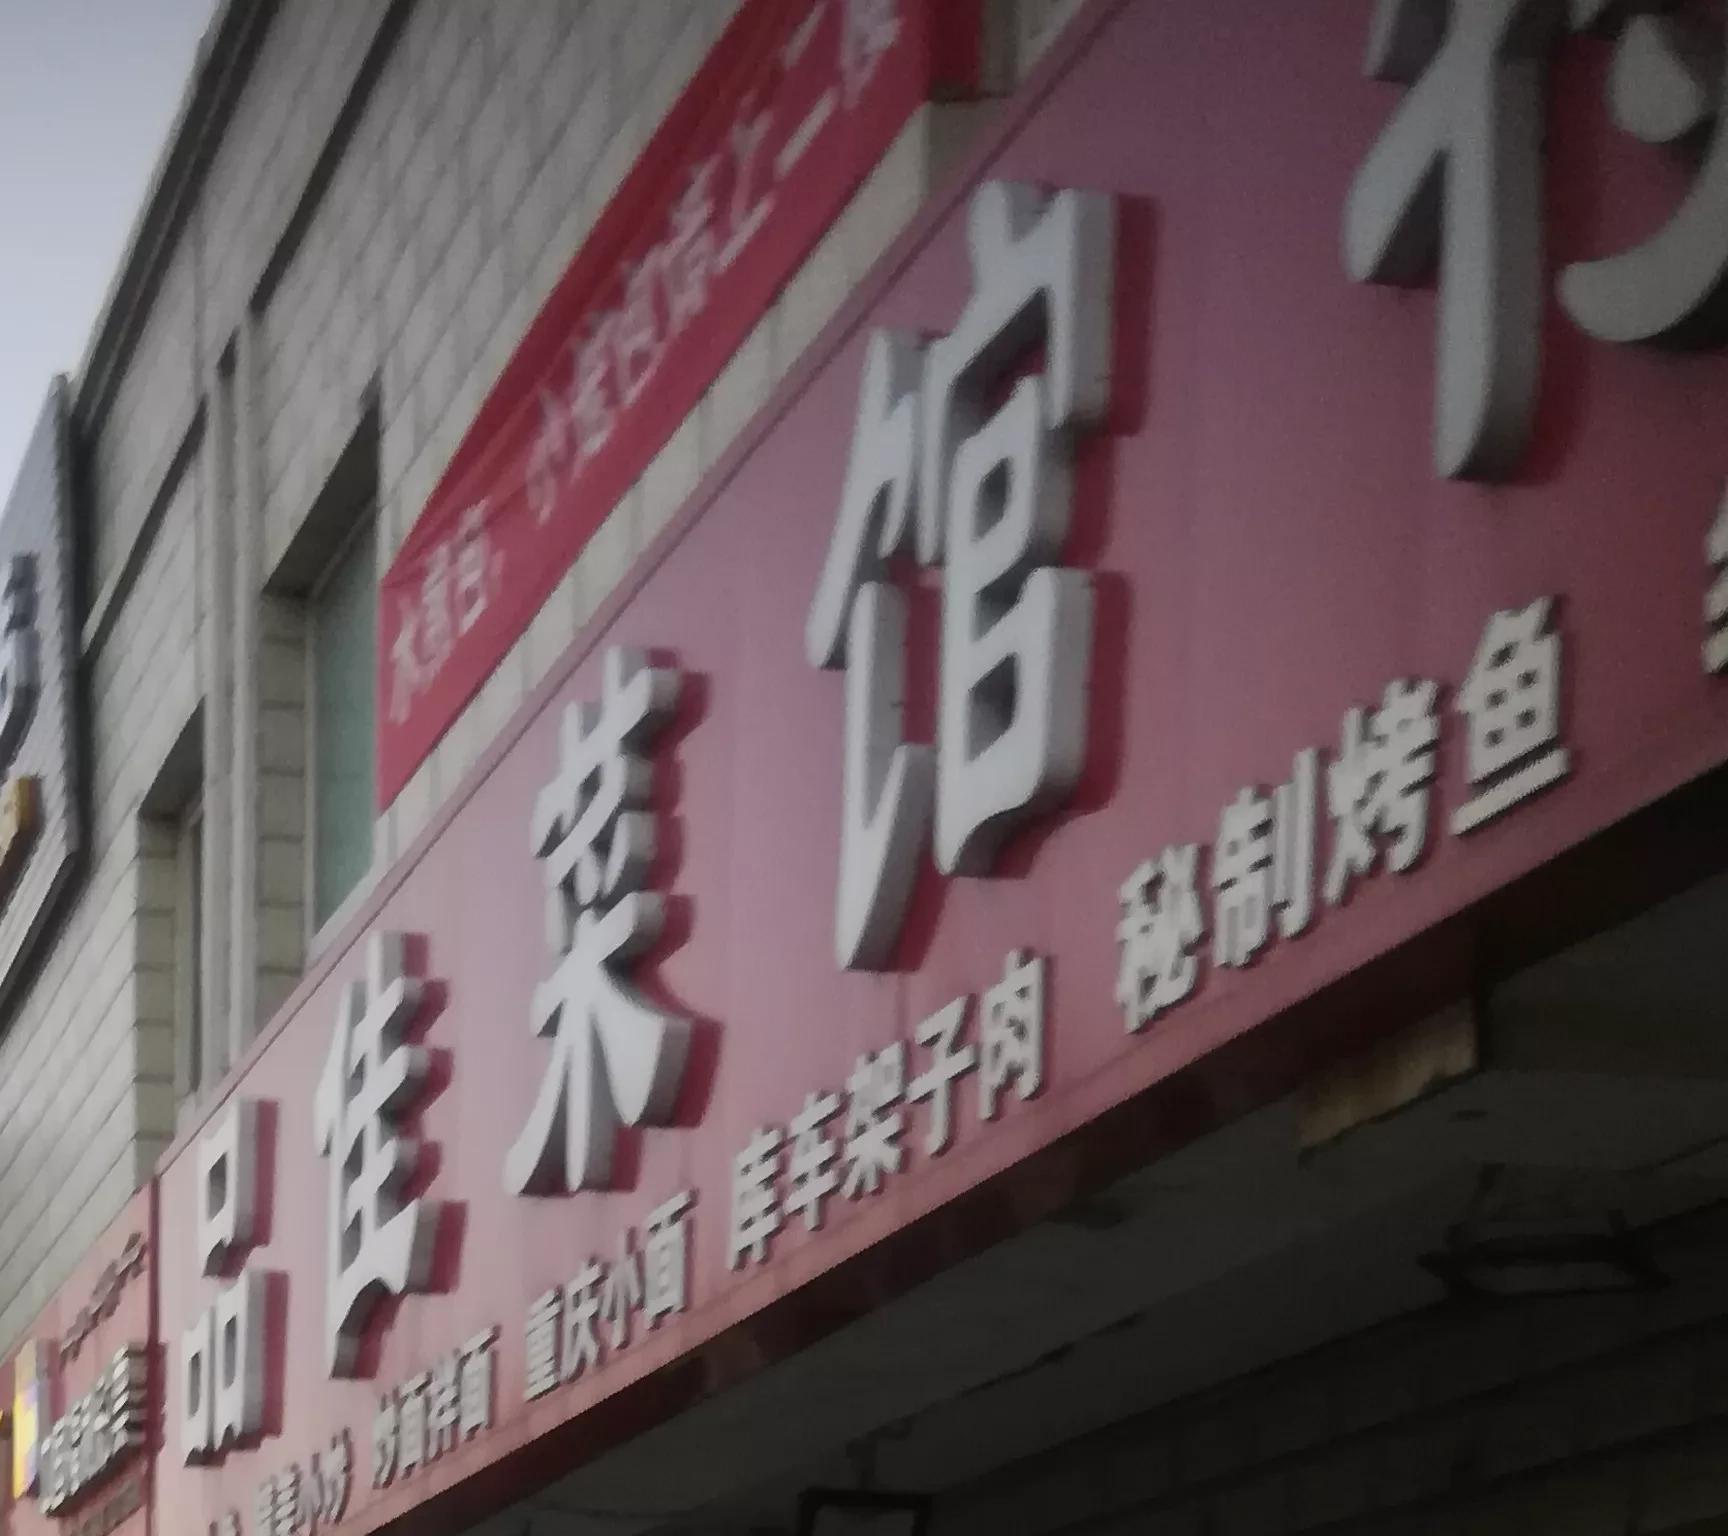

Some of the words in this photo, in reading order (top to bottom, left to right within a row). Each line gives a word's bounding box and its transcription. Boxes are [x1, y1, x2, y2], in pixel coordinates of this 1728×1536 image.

[524, 1191, 697, 1403] 重庆小面
[726, 948, 1052, 1272] 库车架子肉
[1116, 595, 1573, 1035] 秘制烤鱼
